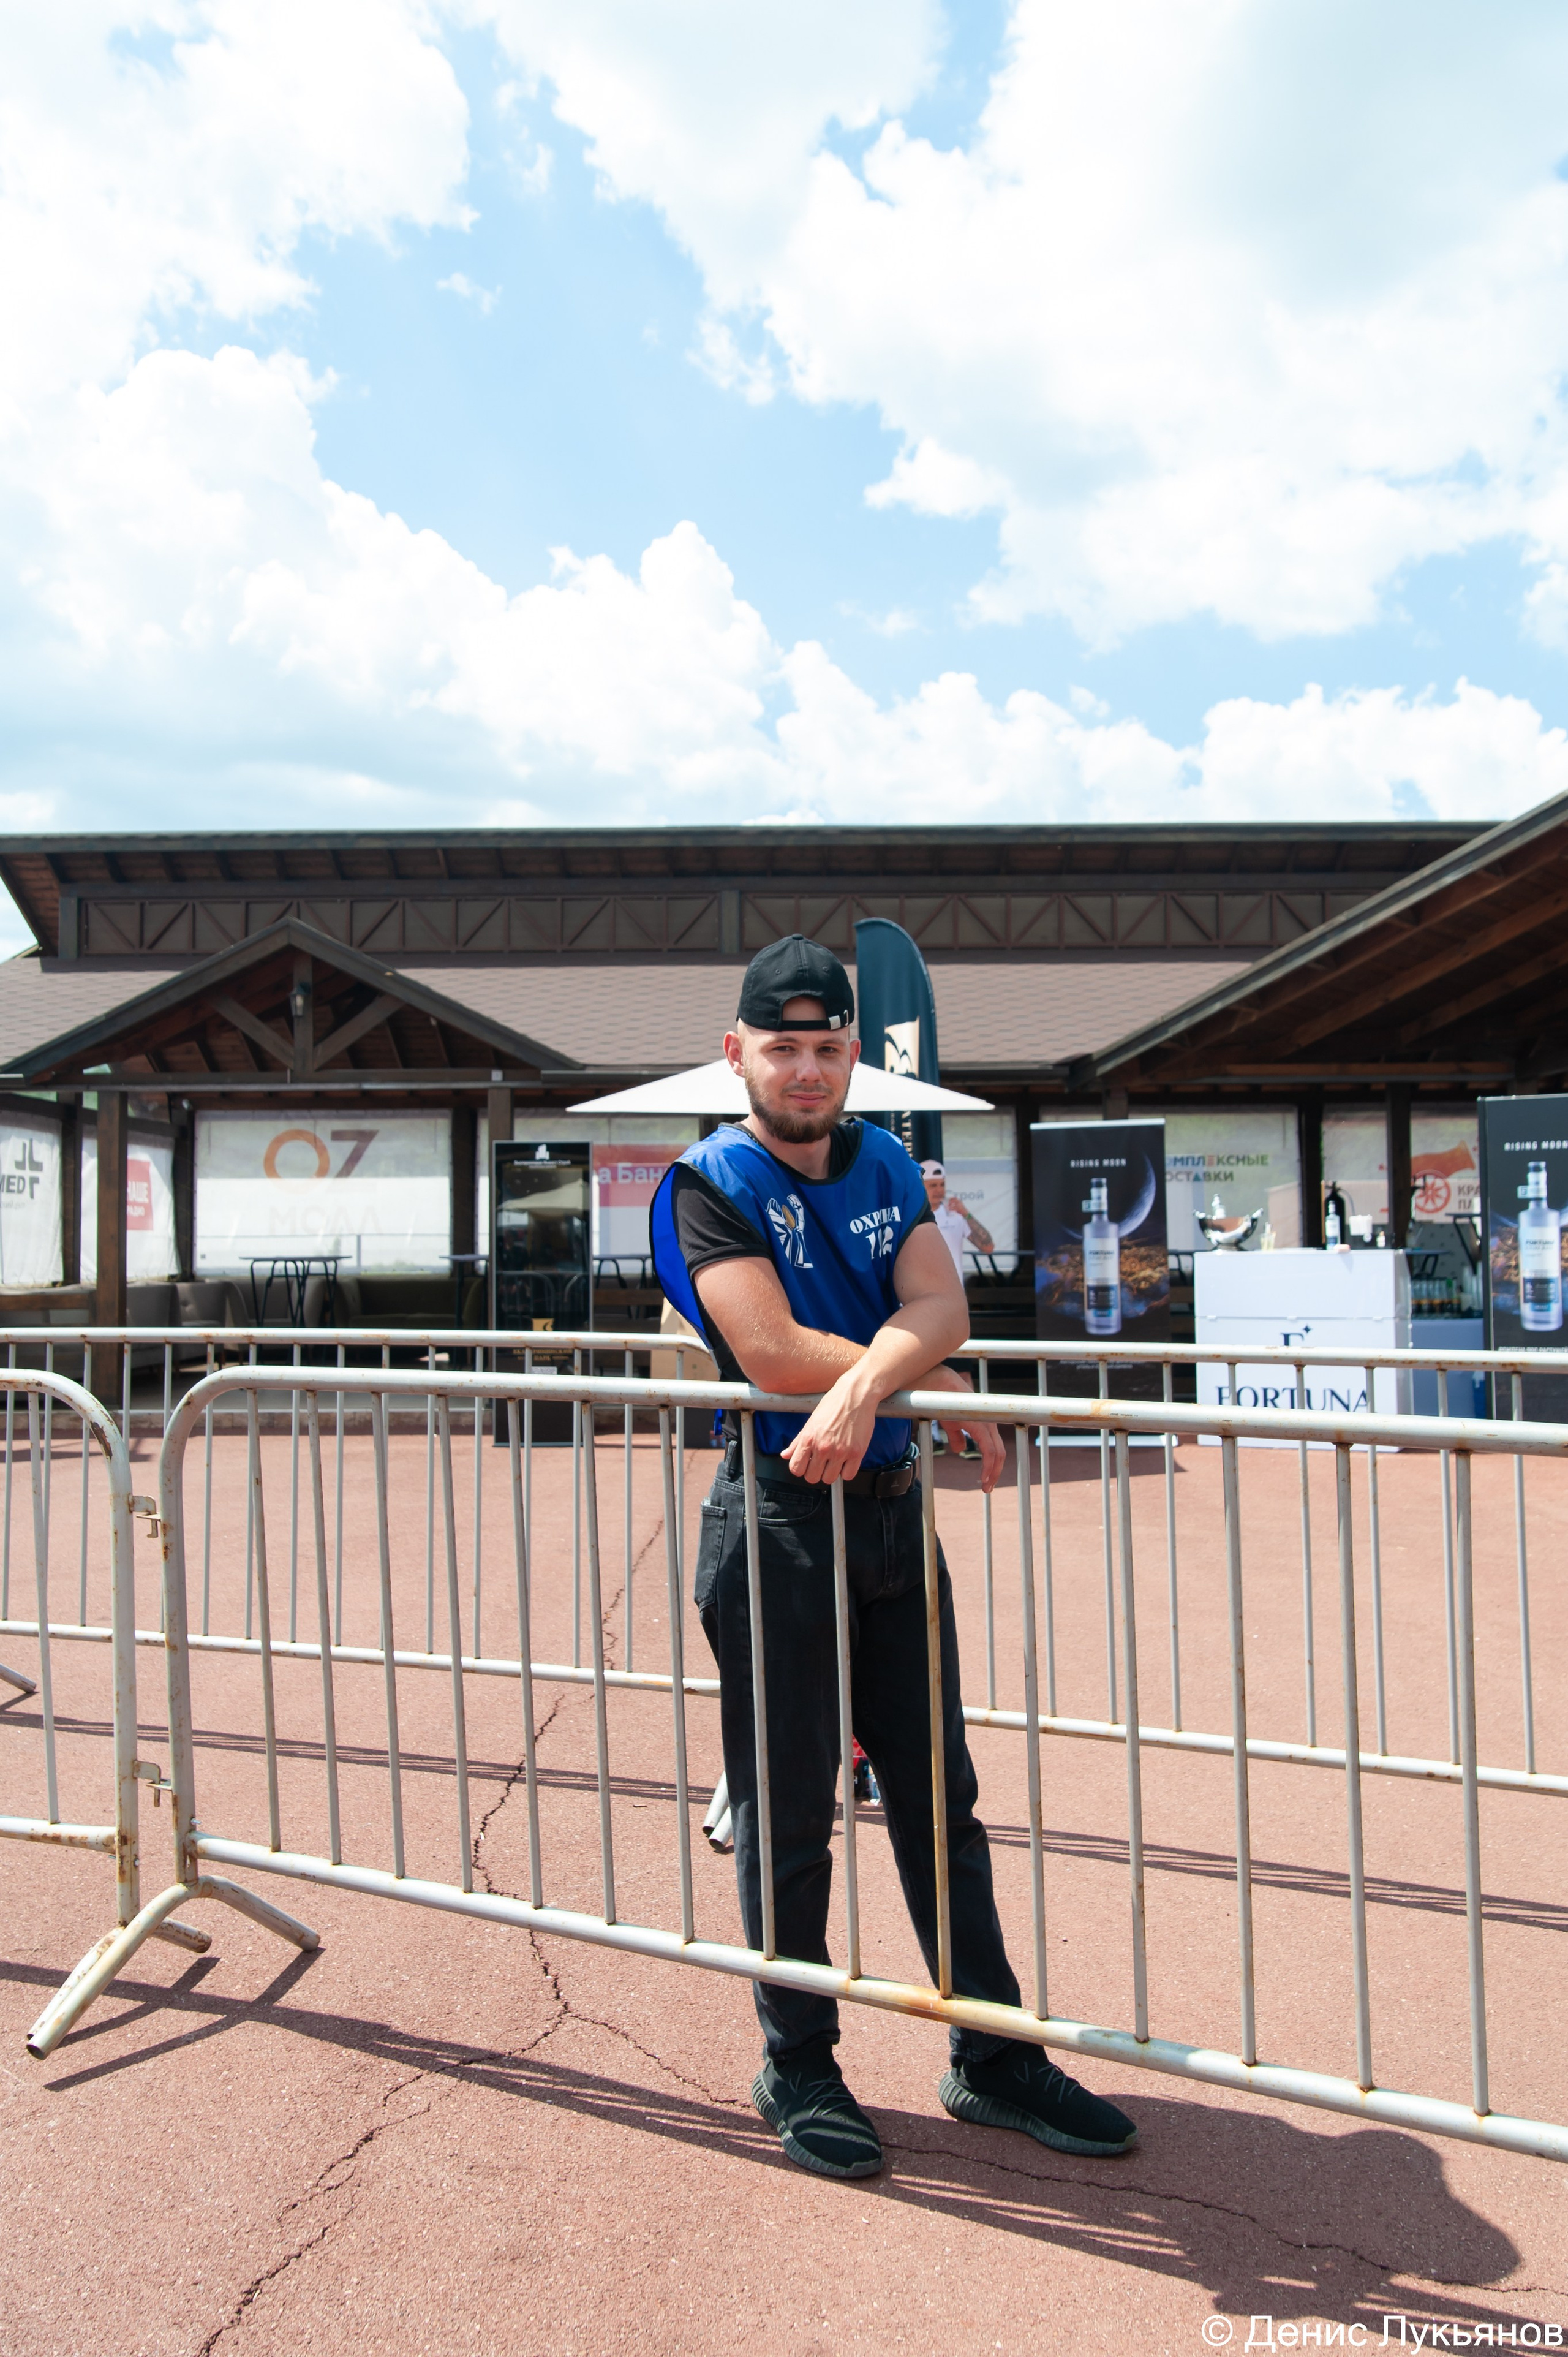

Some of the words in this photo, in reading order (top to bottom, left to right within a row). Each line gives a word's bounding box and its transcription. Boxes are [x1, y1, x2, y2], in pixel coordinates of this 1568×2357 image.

[1504, 1141, 1537, 1151] RISING
[1541, 1140, 1568, 1150] MOON
[1070, 1159, 1099, 1168] RISING
[1102, 1157, 1126, 1167] MOON
[617, 1162, 666, 1184] Бан
[1216, 1385, 1378, 1412] FORTUNA
